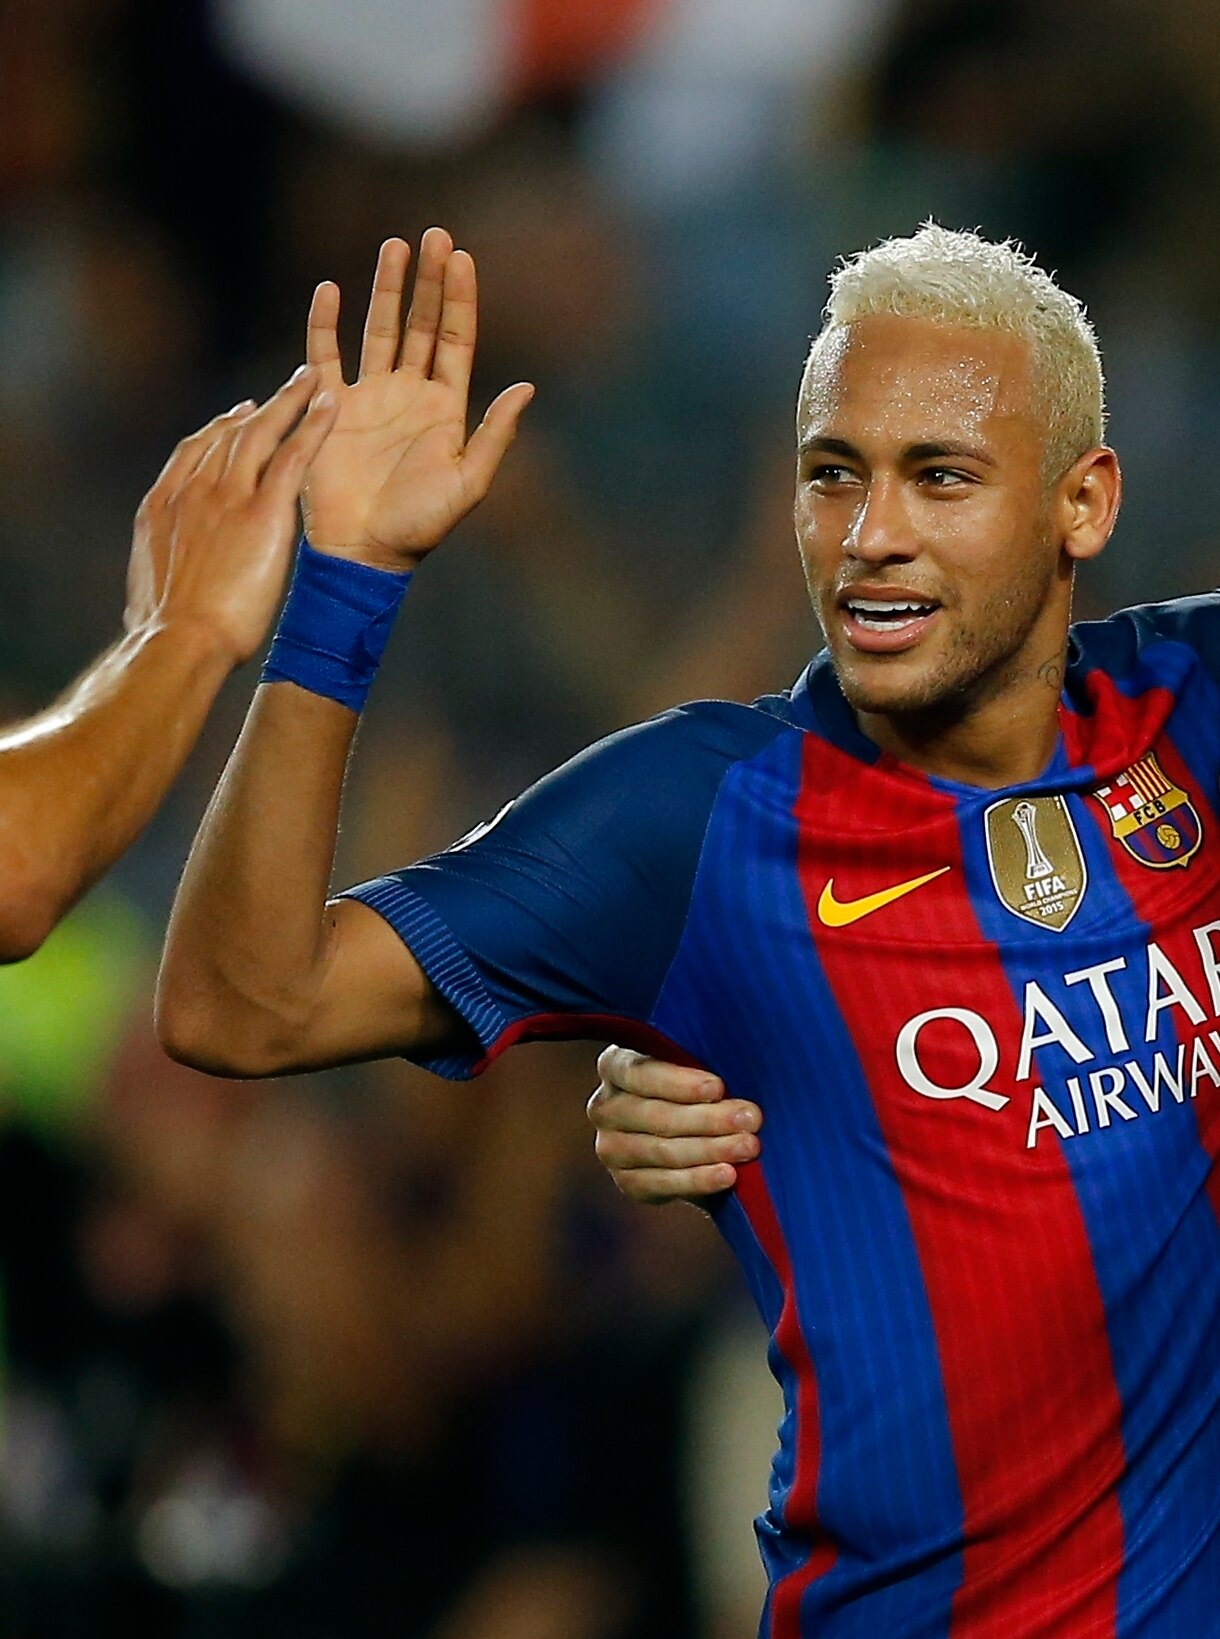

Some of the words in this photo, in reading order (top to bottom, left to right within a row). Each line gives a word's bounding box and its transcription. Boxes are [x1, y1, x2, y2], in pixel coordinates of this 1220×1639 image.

[1133, 800, 1166, 826] FCB
[1023, 876, 1066, 901] FIFA
[1039, 901, 1065, 917] 2015
